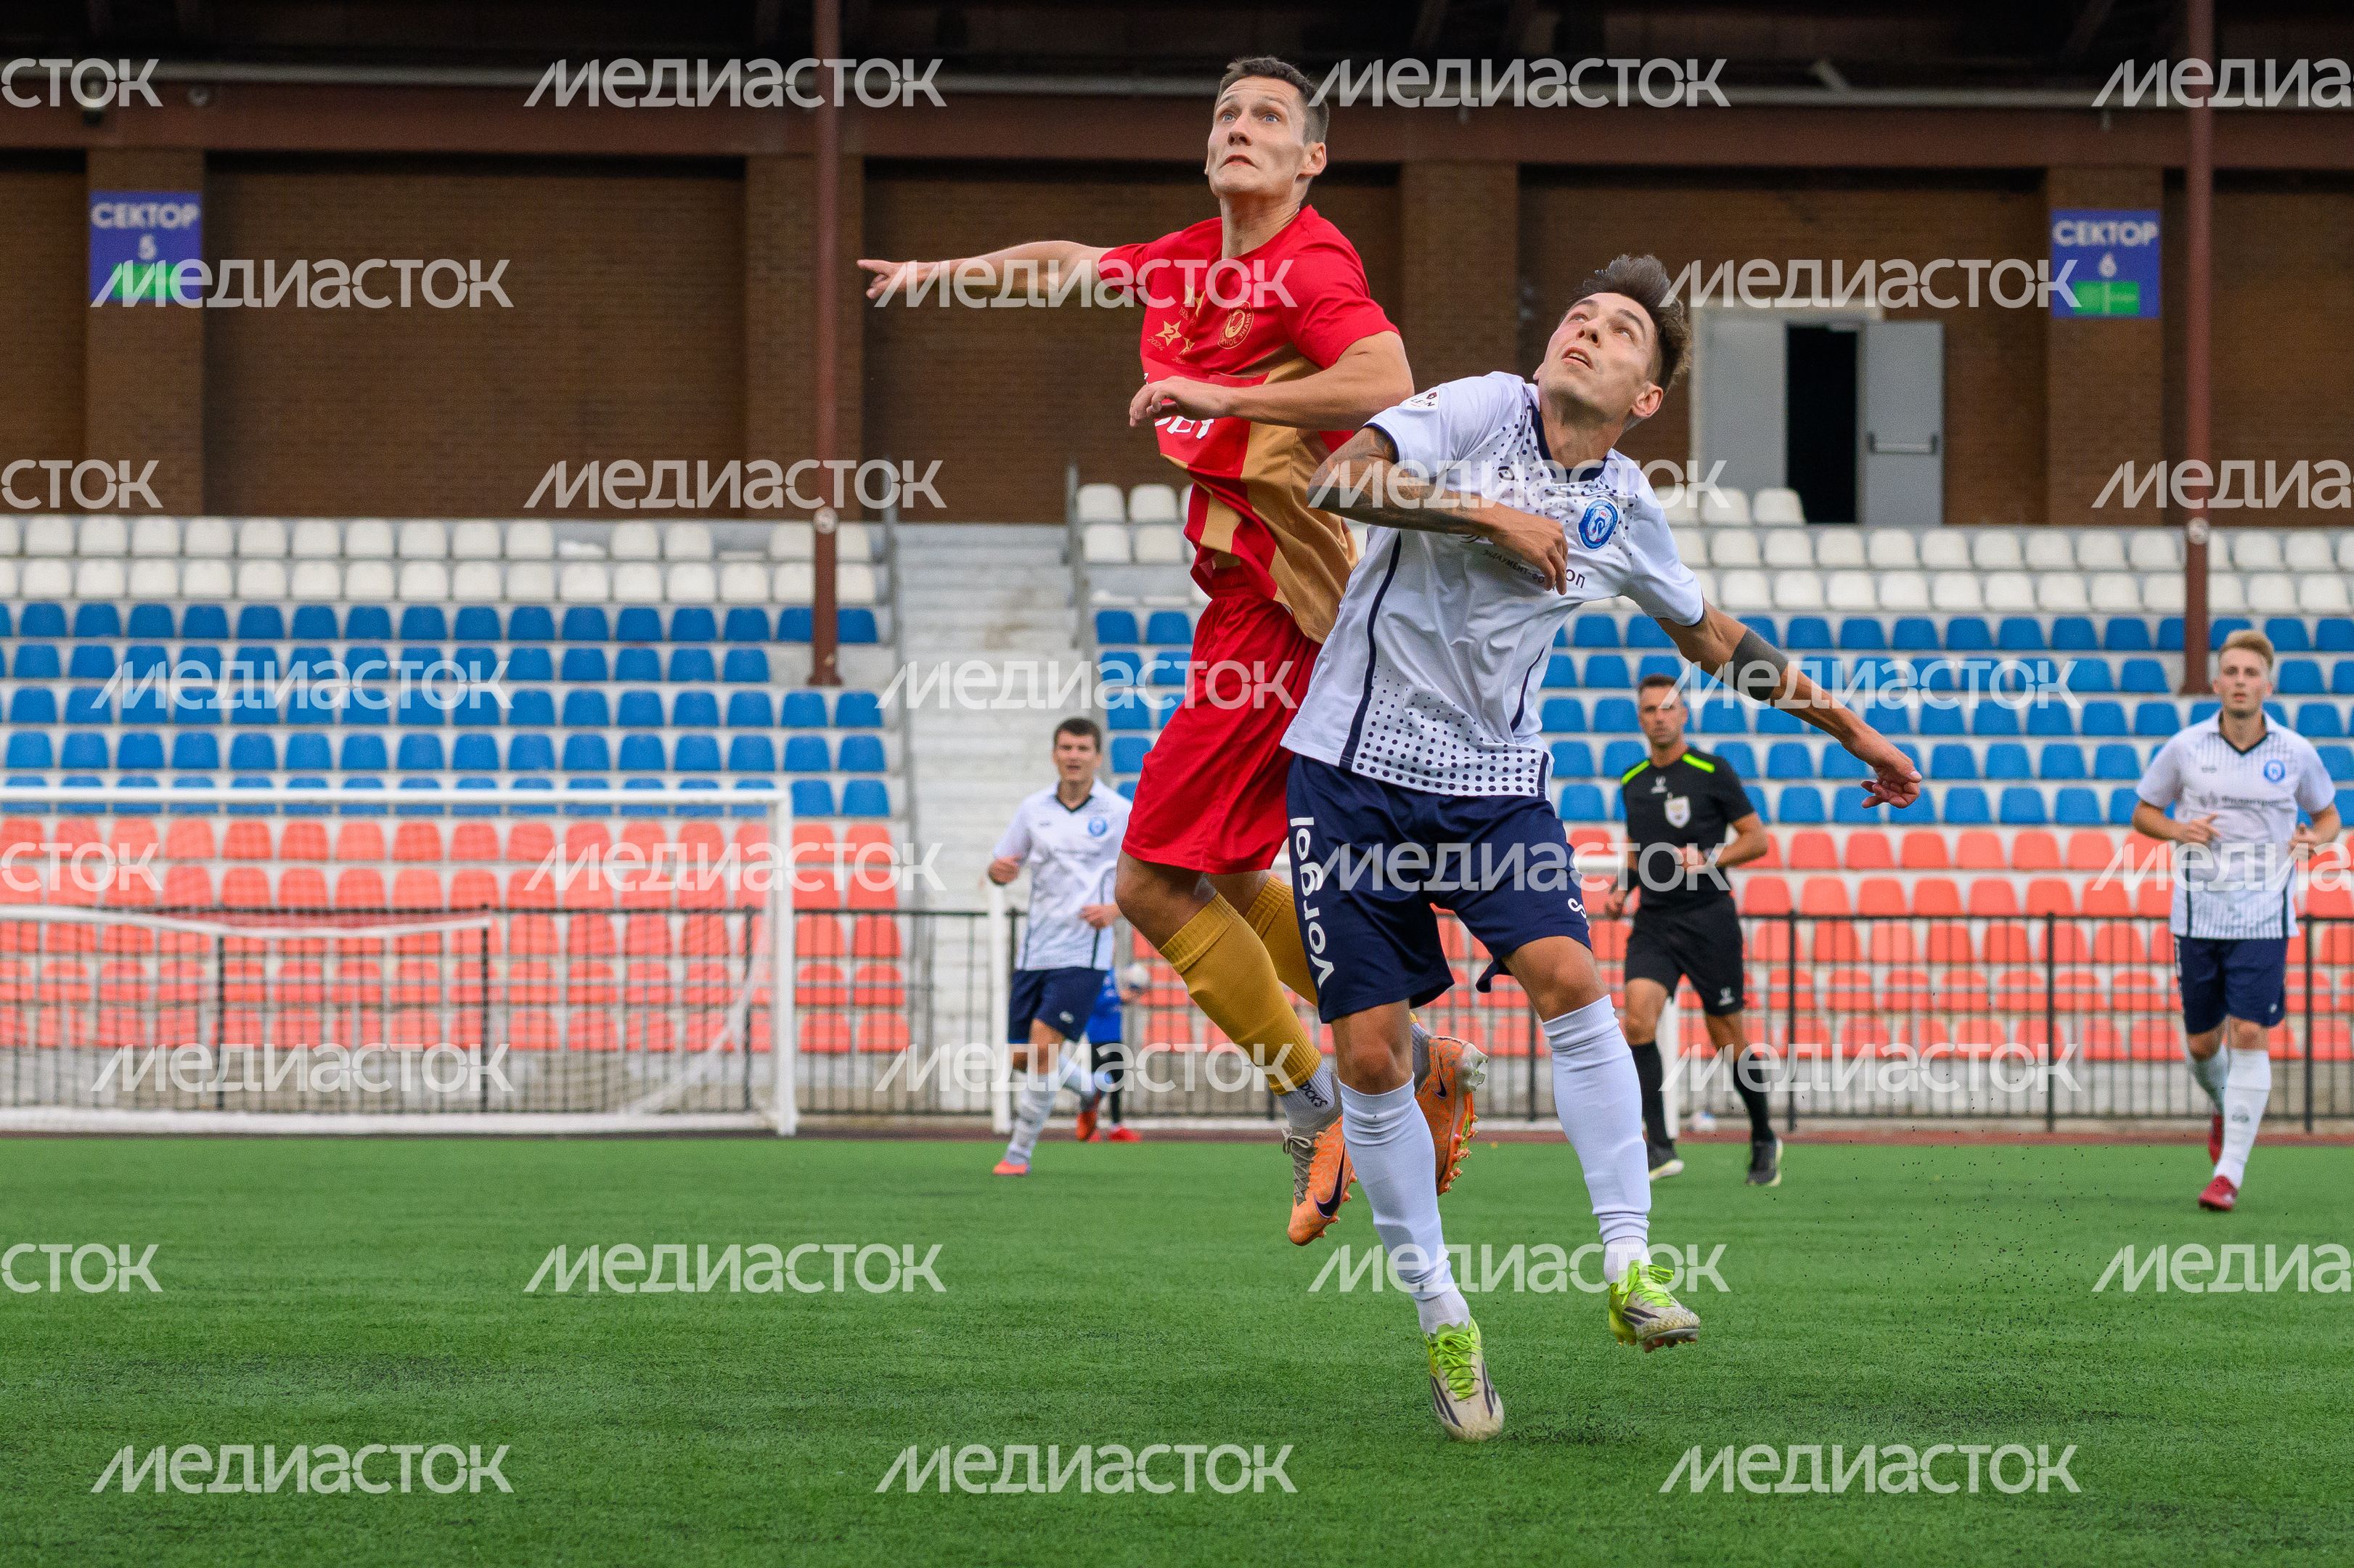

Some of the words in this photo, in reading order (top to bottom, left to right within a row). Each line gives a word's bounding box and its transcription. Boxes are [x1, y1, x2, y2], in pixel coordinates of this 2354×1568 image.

[91, 202, 200, 229] СЕКТОР
[2053, 219, 2159, 247] СЕКТОР
[1146, 336, 1164, 351] 2024
[1164, 327, 1177, 340] 2
[1482, 549, 1555, 589] ЭНДАУМЕНТ-ФО
